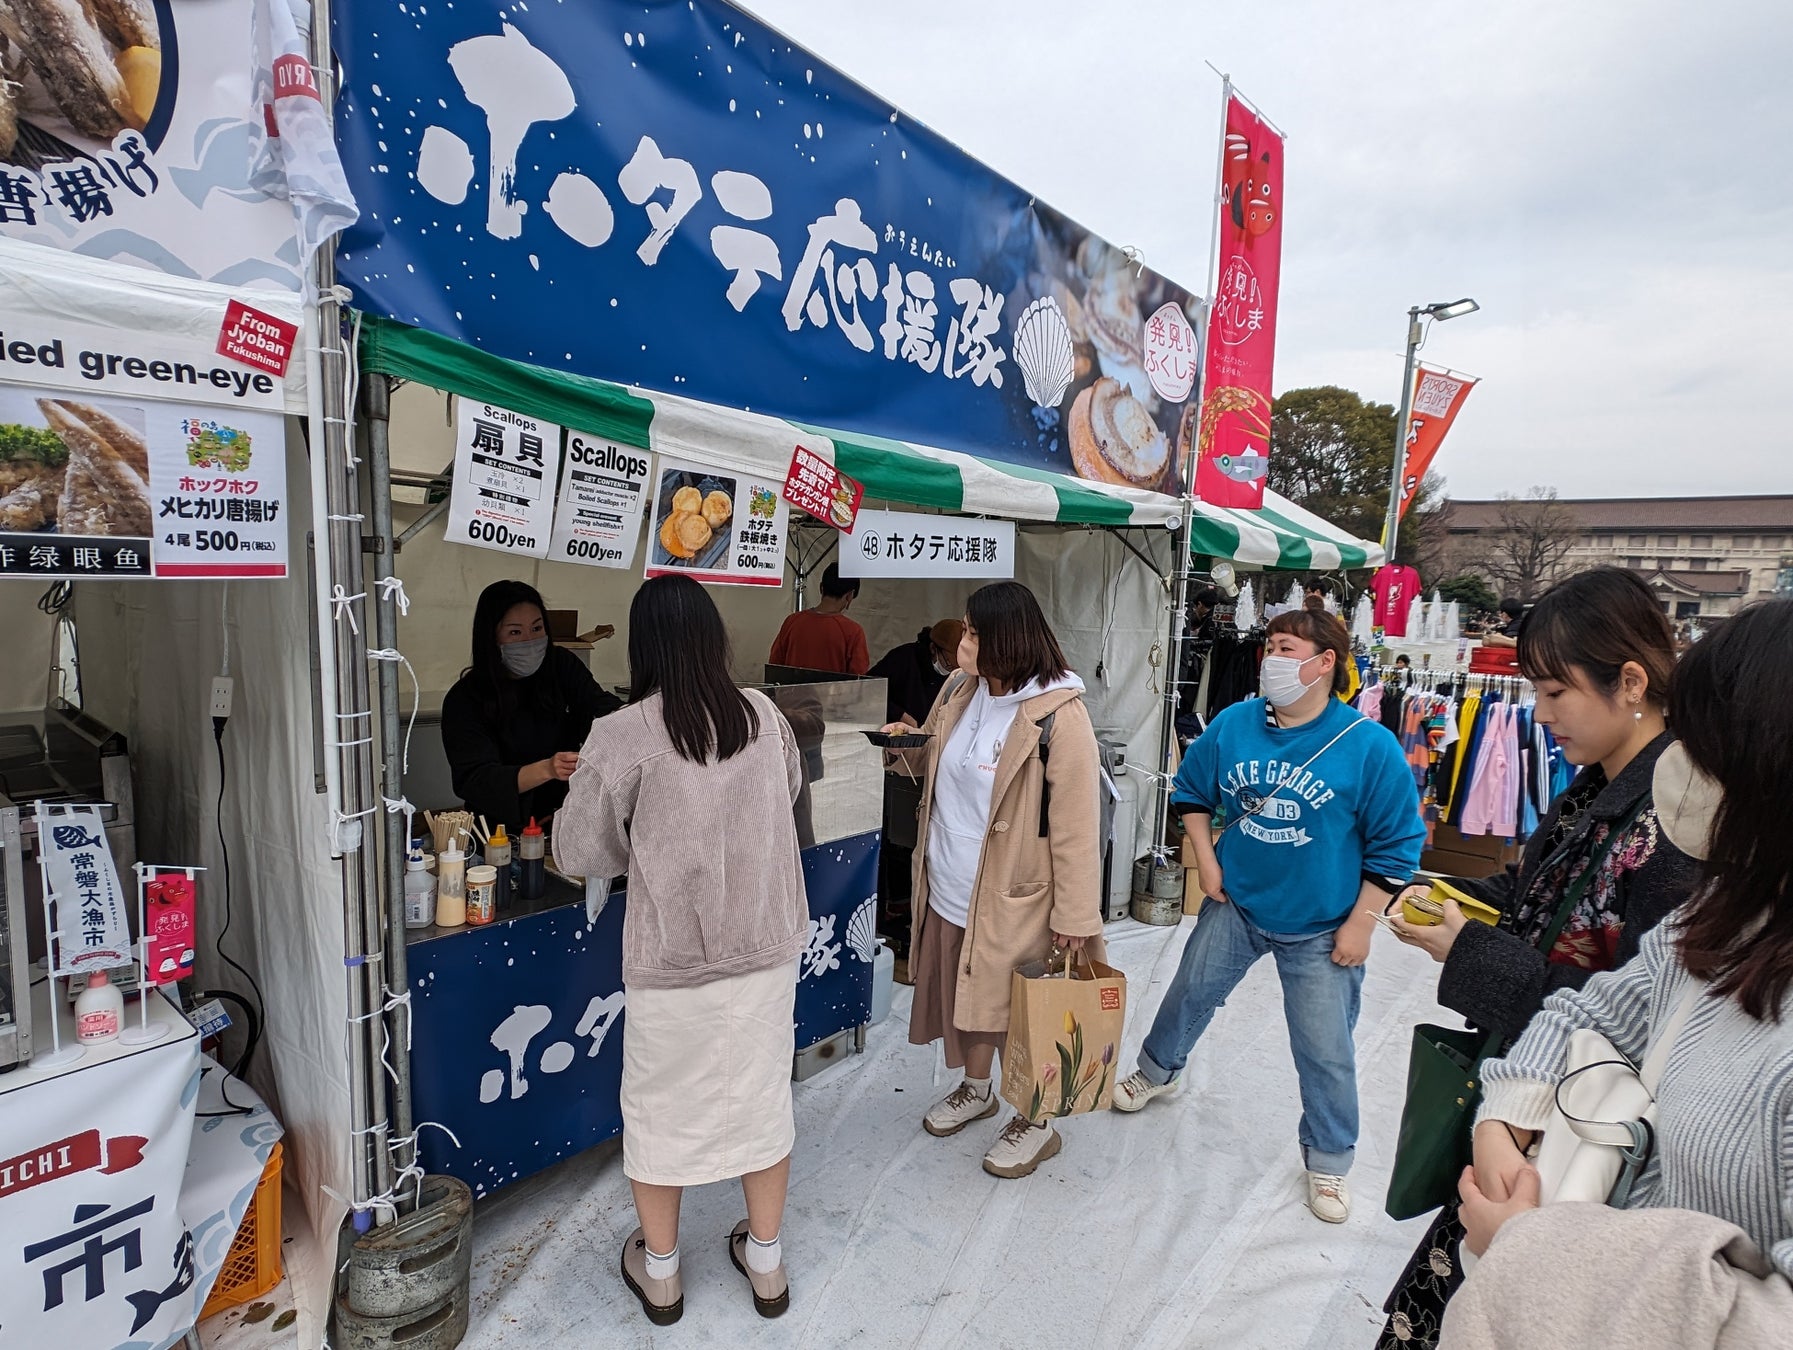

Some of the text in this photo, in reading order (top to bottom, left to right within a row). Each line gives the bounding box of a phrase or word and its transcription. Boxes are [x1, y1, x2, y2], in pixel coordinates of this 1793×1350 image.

[885, 223, 956, 268] おうえんたい
[240, 311, 281, 339] From
[228, 324, 285, 356] Jyoban
[227, 341, 281, 369] Fukushima
[1145, 350, 1196, 382] ふくしま
[79, 350, 274, 397] green-eye
[484, 405, 537, 432] Scallops
[485, 459, 531, 476] SET CONTENTS
[571, 437, 647, 479] Scallops
[796, 449, 836, 484] 数量限定
[179, 476, 259, 495] ホックホク
[584, 475, 629, 489] SET CONTENTS
[159, 496, 280, 523] メヒカリ唐揚げ
[597, 497, 619, 508] Scallops
[469, 519, 536, 549] 600yen
[572, 519, 591, 527] young
[748, 519, 773, 531] ホタテ
[567, 539, 622, 561] 600yen
[739, 531, 778, 546] 鉄板焼き
[886, 533, 997, 563] ホタテ応援隊
[1218, 760, 1335, 810] LAKE GEORGE
[1276, 803, 1296, 819] 03
[1246, 823, 1295, 841] NEW YORK
[70, 852, 106, 947] 常磐大漁市
[1040, 1091, 1108, 1111] SPRING
[1, 1145, 72, 1189] ICHI
[24, 1195, 155, 1311] 市
